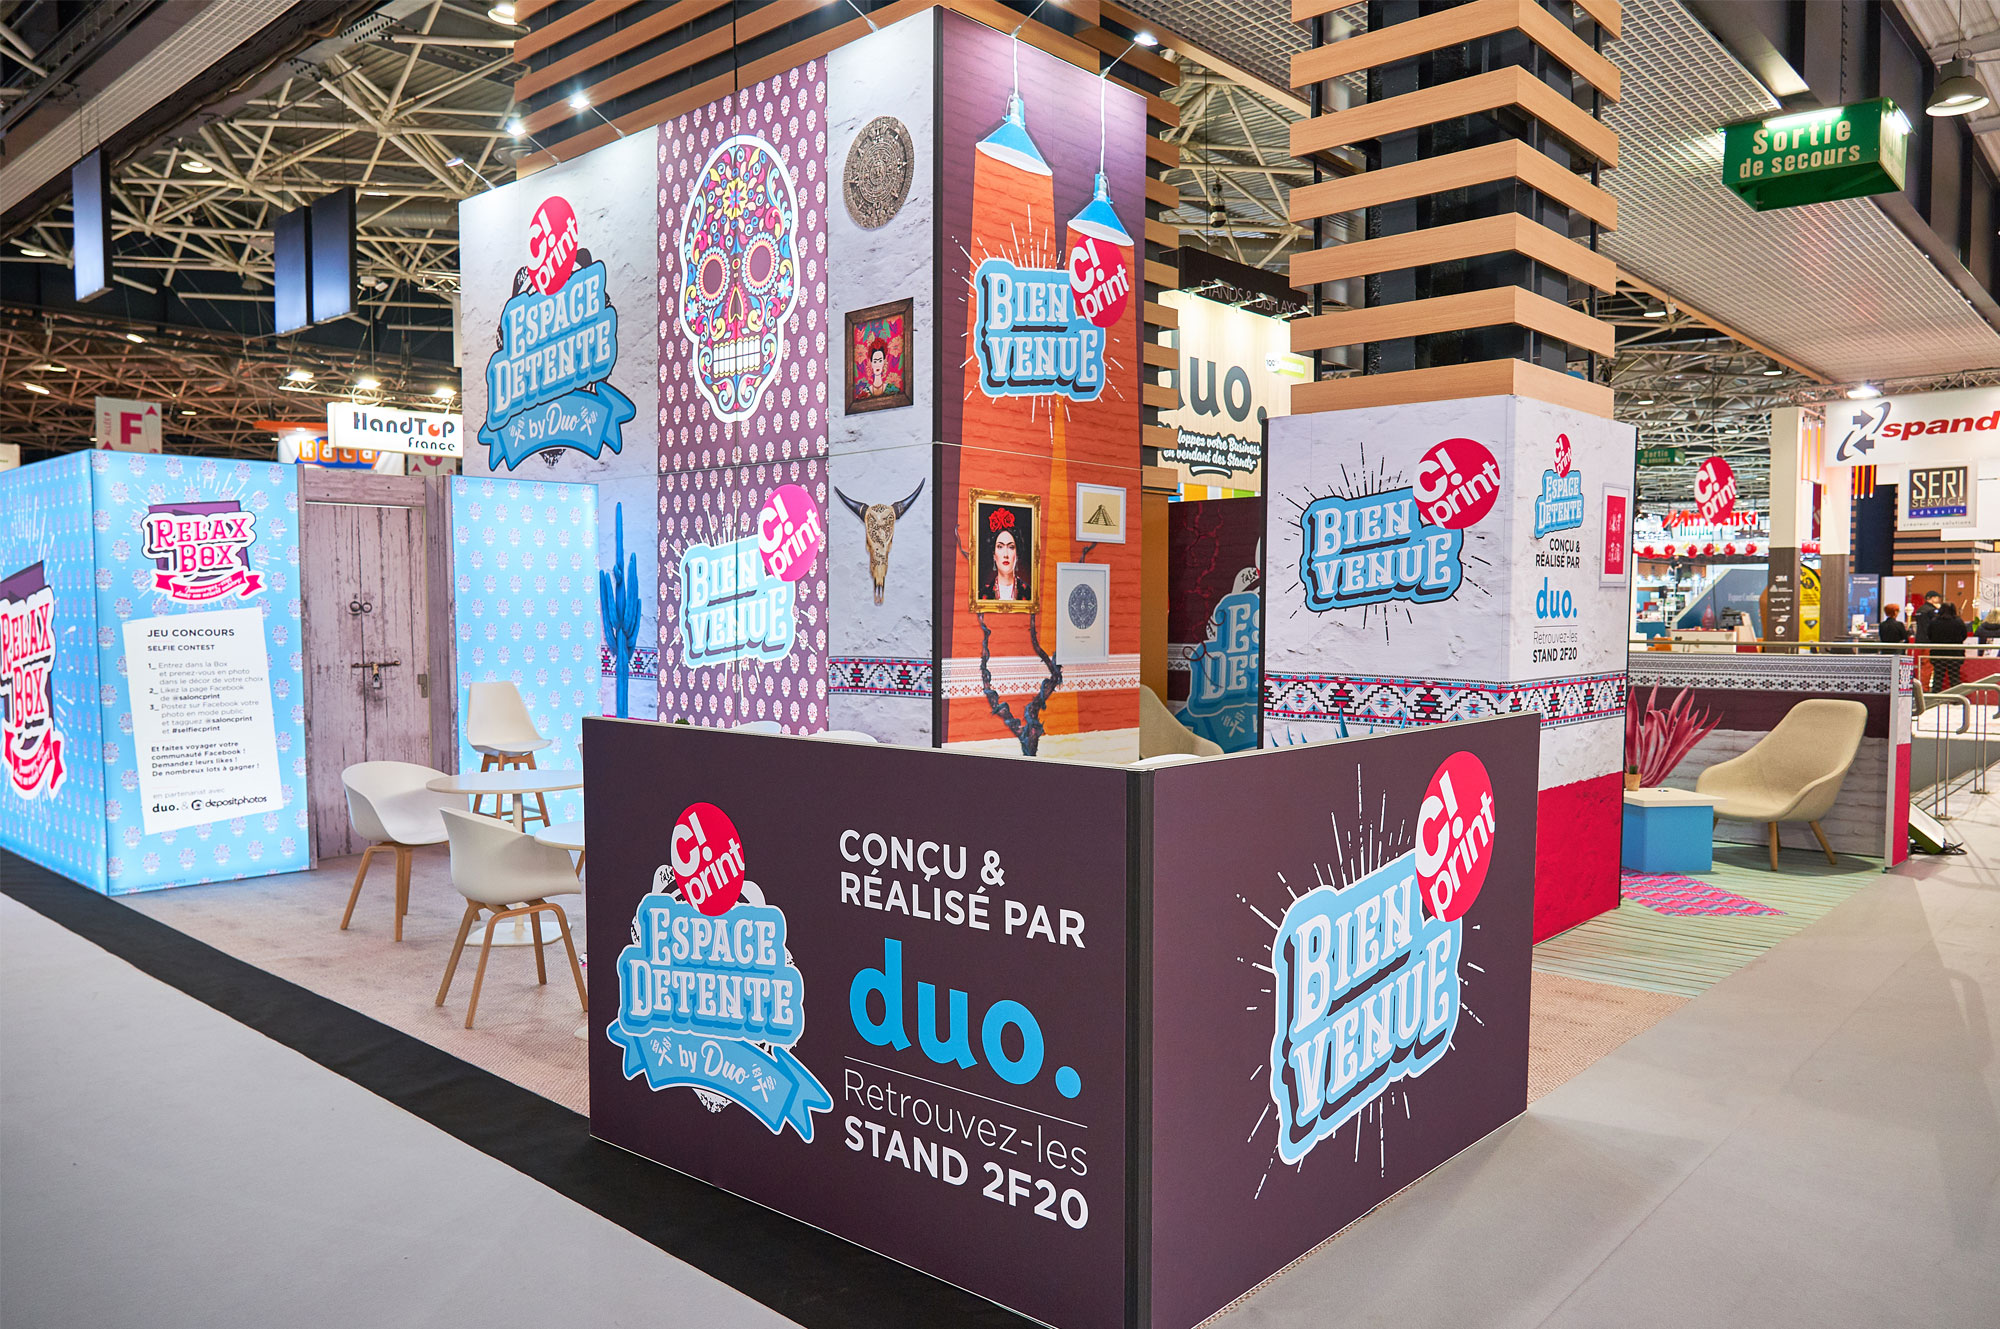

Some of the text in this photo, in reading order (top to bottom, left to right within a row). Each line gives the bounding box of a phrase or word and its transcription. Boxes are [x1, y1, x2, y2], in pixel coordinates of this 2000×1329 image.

[1740, 144, 1860, 179] de secours
[1753, 120, 1851, 155] Sortie
[528, 208, 556, 271] C!
[535, 217, 578, 295] print
[1069, 238, 1105, 293] C!
[509, 275, 600, 360] ESPACE
[989, 273, 1069, 329] BIEN
[1080, 268, 1130, 324] print
[1201, 280, 1243, 302] STANDS
[1256, 293, 1297, 317] DISPLAYS
[494, 320, 610, 413] DETENTE
[989, 329, 1097, 383] VENUE
[1171, 331, 1267, 424] uo.
[120, 412, 143, 445] F
[354, 411, 455, 438] HandTop
[529, 402, 580, 439] by Duo
[1207, 433, 1228, 450] votre
[1228, 437, 1261, 455] Business
[1881, 410, 2000, 441] spand
[1163, 447, 1256, 470] en vendant des Stands
[1413, 447, 1463, 503] C!
[1557, 447, 1571, 476] print
[1694, 462, 1720, 503] C!
[1912, 469, 1964, 499] SERI
[1428, 459, 1500, 528] print
[1538, 499, 1581, 529] DETENTE
[1546, 476, 1579, 502] ESPACE
[1702, 476, 1736, 523] print
[1912, 497, 1964, 507] SERVICE
[154, 518, 248, 548] RELAX
[758, 494, 793, 553] C!
[769, 508, 820, 581] print
[1316, 499, 1412, 557] BIEN
[1550, 539, 1580, 552] CONÇU &
[177, 544, 235, 573] BOX
[690, 549, 758, 608] BIEN
[1315, 533, 1451, 595] VENUE
[1536, 552, 1580, 568] RÉALISÉ PAR
[690, 586, 787, 649] VENUE
[1536, 577, 1577, 619] duo.
[1, 603, 51, 674] RELAX
[147, 628, 235, 637] JEU CONCOURS
[1533, 631, 1578, 644] Retrouvez-les
[1533, 646, 1578, 663] STAND 2F20
[14, 667, 44, 728] BOX
[221, 708, 244, 716] public
[152, 752, 201, 760] communauté
[165, 768, 204, 776] nombreux
[230, 764, 254, 772] gagner
[152, 804, 180, 813] duo.
[205, 796, 267, 808] depositphotos
[1416, 770, 1463, 878] C!
[671, 811, 713, 876] C!
[839, 829, 1005, 886] CONÇU &
[1429, 791, 1496, 919] print
[684, 838, 745, 909] print
[840, 868, 1086, 948] RÉALISÉ PAR
[649, 908, 776, 966] ESPACE
[1294, 875, 1415, 1033] BIEN
[630, 960, 793, 1025] DETENTE
[850, 938, 1082, 1099] duo.
[1293, 929, 1452, 1117] VENUE
[678, 1040, 750, 1085] by Duo
[844, 1069, 1088, 1176] Retrouvez-les
[844, 1116, 1089, 1230] STAND 2F20
